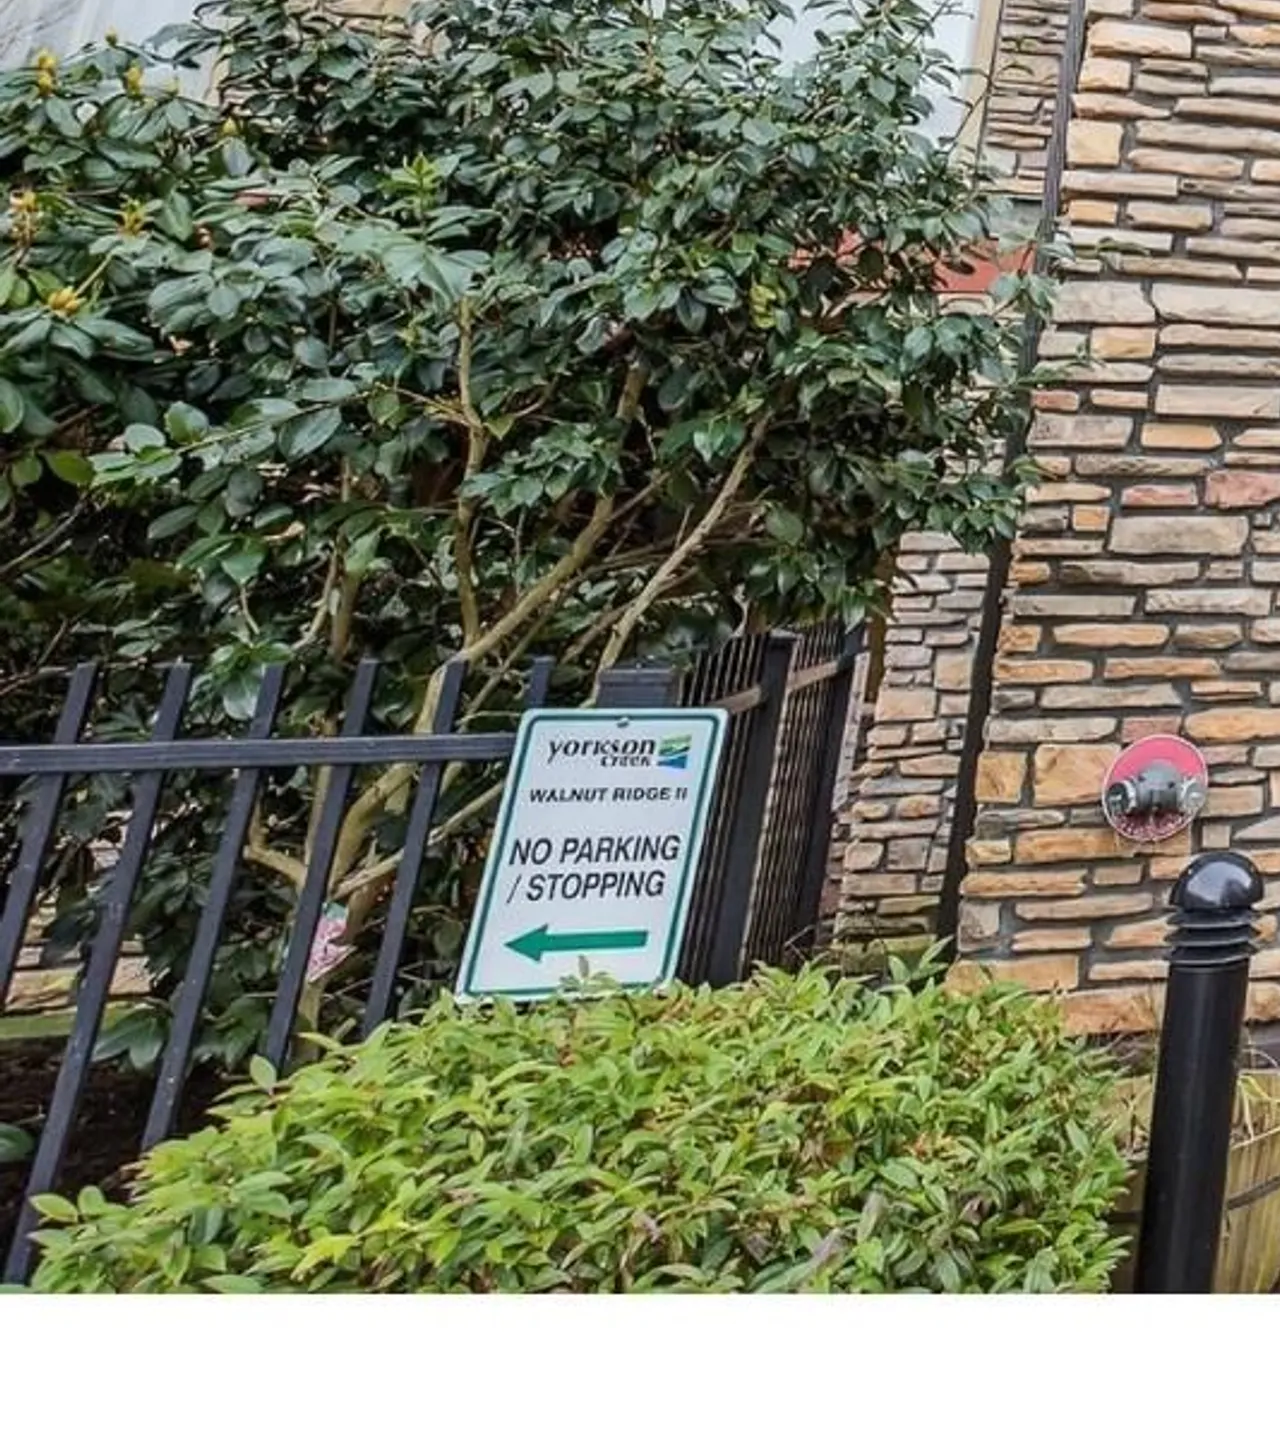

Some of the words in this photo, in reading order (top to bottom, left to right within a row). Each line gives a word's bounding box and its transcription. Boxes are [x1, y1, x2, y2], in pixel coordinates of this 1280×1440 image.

[529, 787, 608, 803] WALNUT
[612, 787, 671, 802] RIDGE
[508, 837, 553, 866] NO
[559, 834, 681, 865] PARKING
[526, 870, 666, 902] STOPPING
